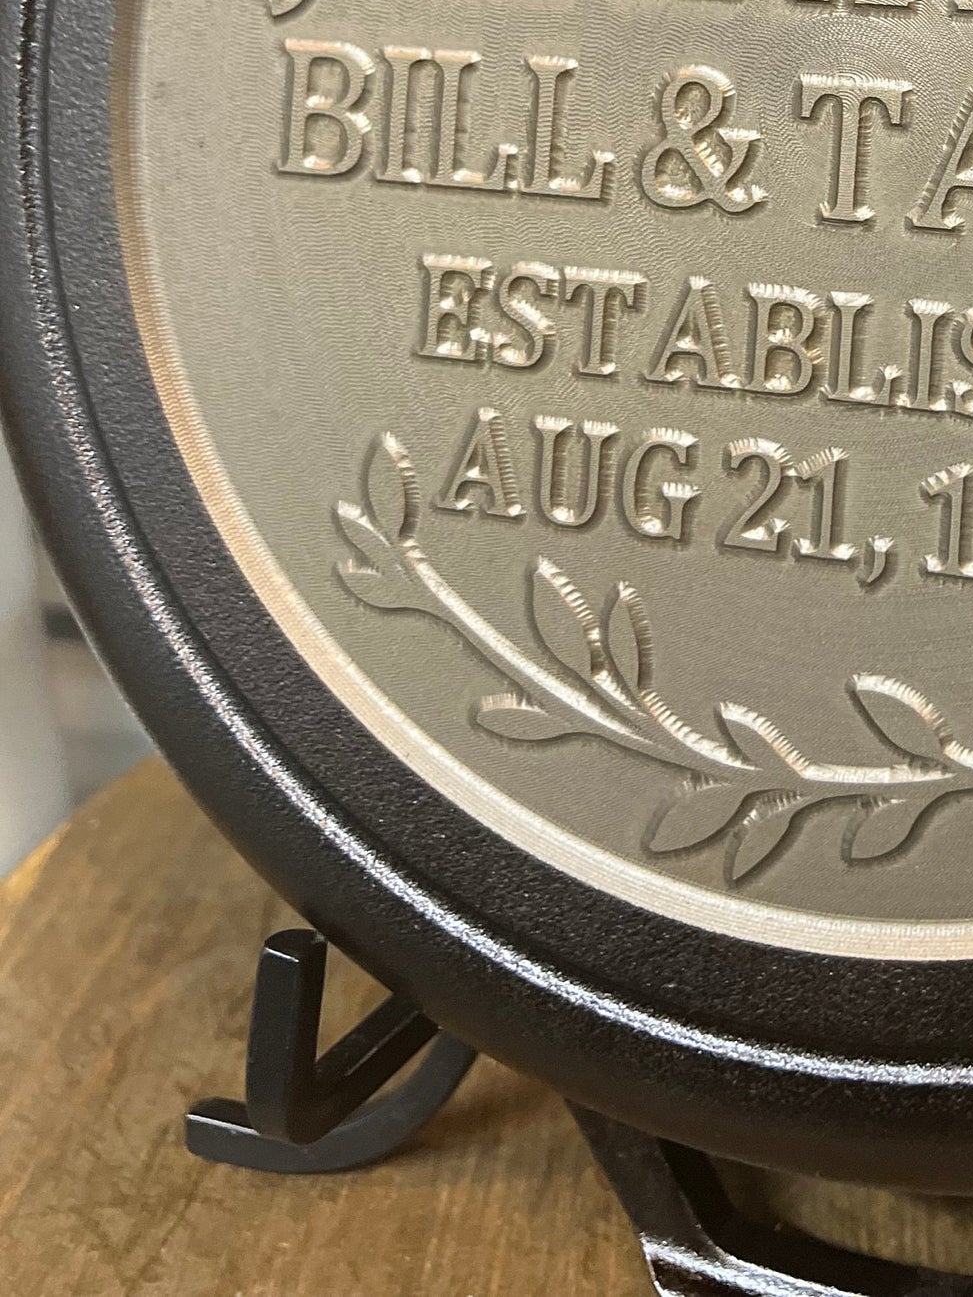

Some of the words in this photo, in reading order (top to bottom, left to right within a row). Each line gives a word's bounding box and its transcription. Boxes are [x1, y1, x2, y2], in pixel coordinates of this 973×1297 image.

[272, 35, 615, 202] BILL
[639, 62, 769, 216] &
[435, 406, 700, 542] AUG
[720, 436, 894, 586] 21,
